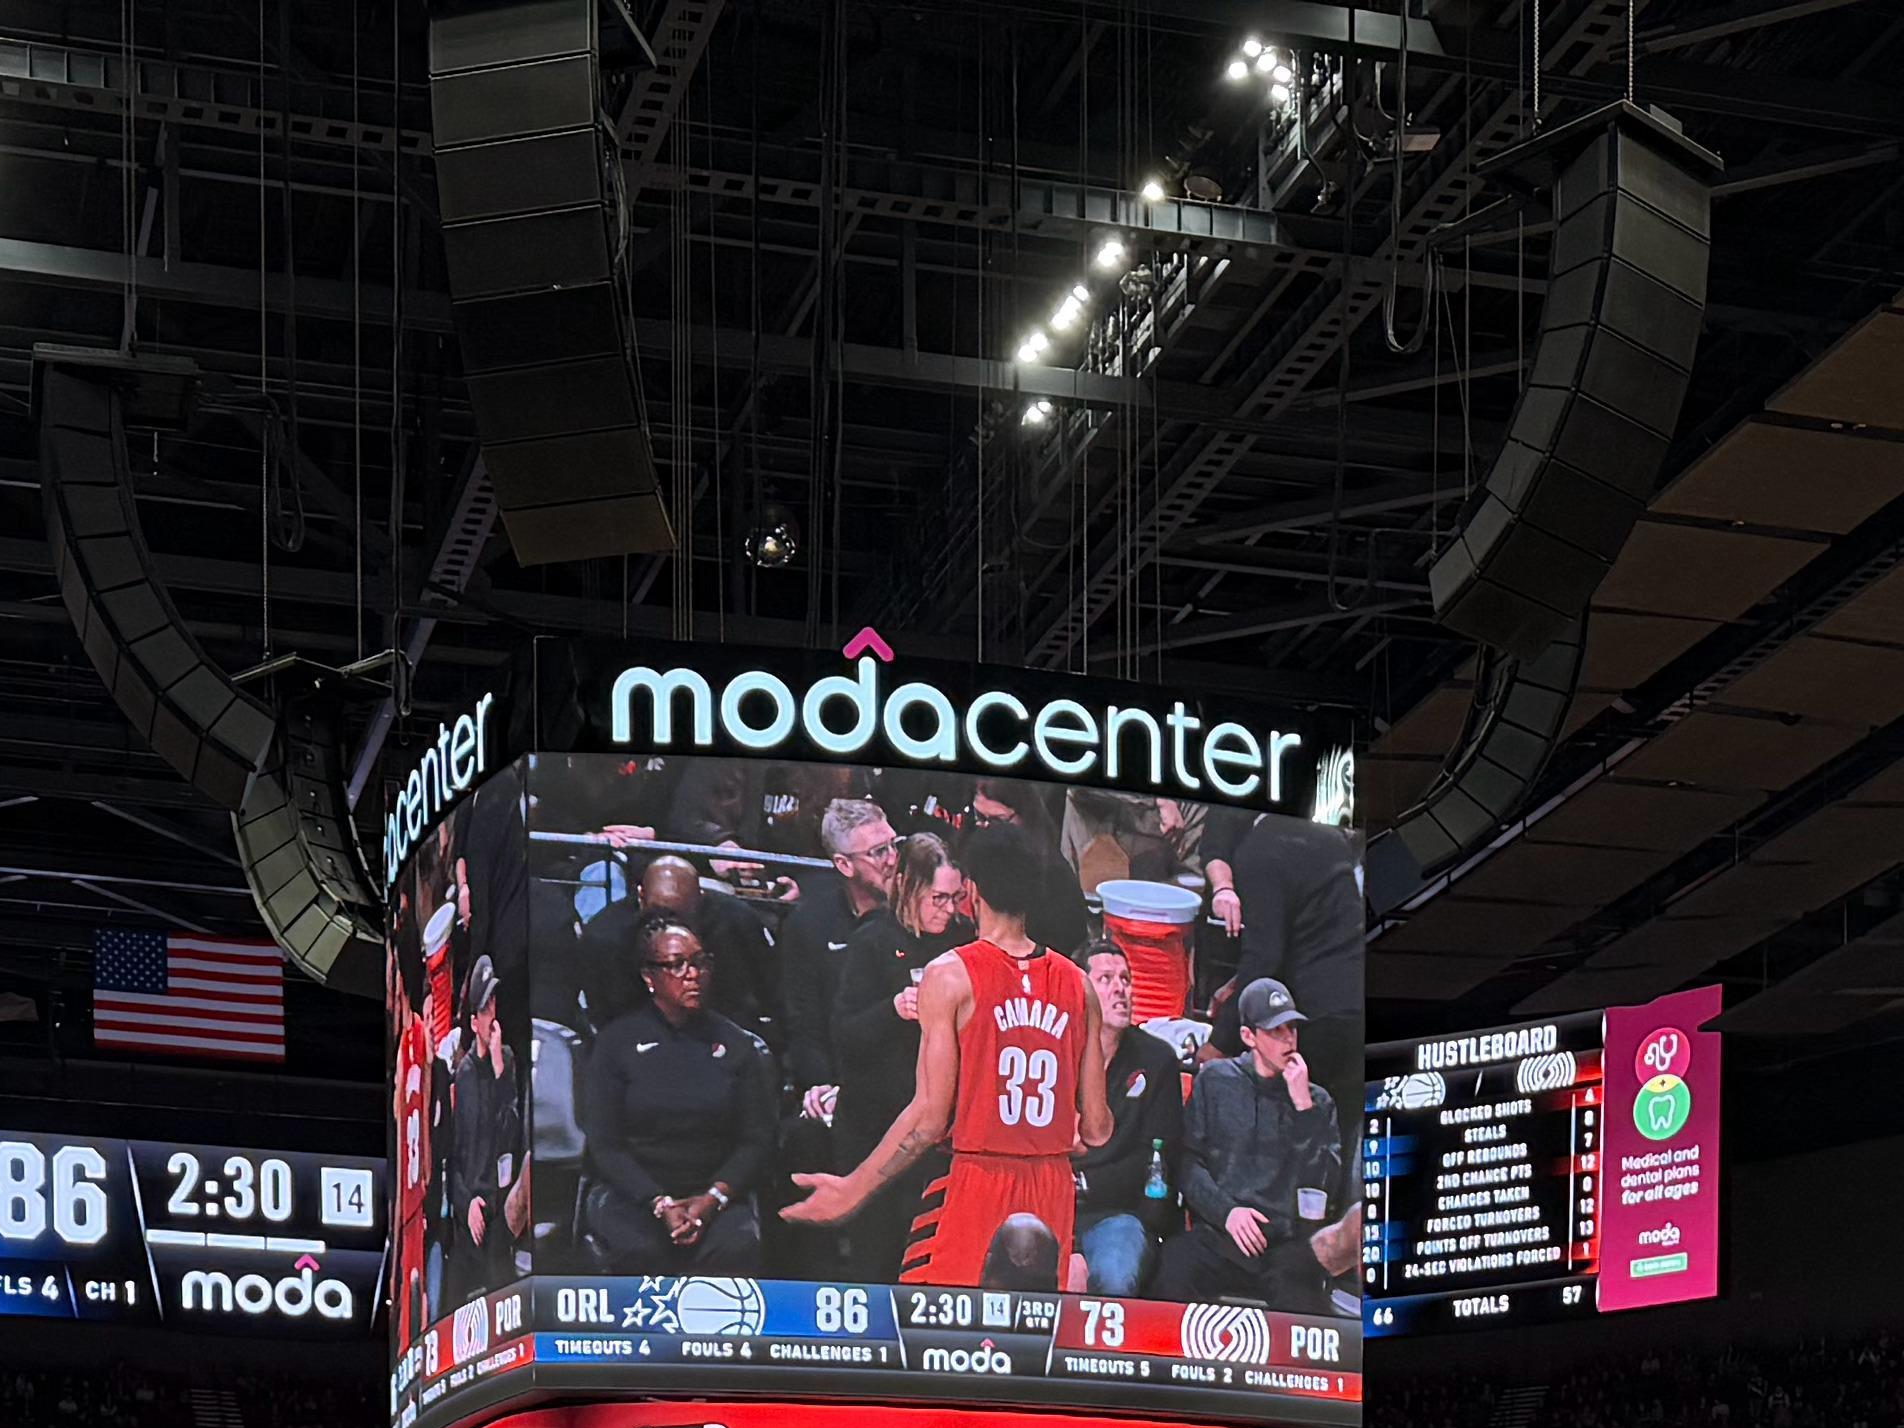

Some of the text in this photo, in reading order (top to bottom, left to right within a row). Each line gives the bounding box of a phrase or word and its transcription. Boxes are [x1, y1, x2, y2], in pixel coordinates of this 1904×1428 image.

[1417, 1024, 1557, 1070] HUSTLEBOARD
[996, 1045, 1059, 1130] 33
[1621, 1144, 1700, 1171] Medical and
[167, 1152, 293, 1221] 2:30
[1620, 1163, 1700, 1189] dental plans
[332, 1182, 365, 1214] 14
[41, 1276, 59, 1299] 4
[85, 1280, 116, 1300] CH
[181, 1267, 353, 1318] moda
[496, 1295, 522, 1335] POR
[557, 1288, 614, 1324] ORL
[815, 1287, 869, 1333] 86
[910, 1293, 971, 1326] 2:30
[1023, 1301, 1055, 1319] 3RD
[1373, 1285, 1582, 1325] 66 TOTALS 57
[1079, 1300, 1124, 1347] 73
[555, 1339, 651, 1355] TIMEOUTS 4
[682, 1342, 752, 1359] FOULS 4
[770, 1343, 871, 1361] CHALLENGES
[1291, 1326, 1340, 1362] POR
[923, 1345, 1011, 1375] moda
[1065, 1357, 1135, 1376] TIMEOUTS
[1172, 1365, 1215, 1381] FOULS
[1245, 1370, 1328, 1391] CHALLENGES
